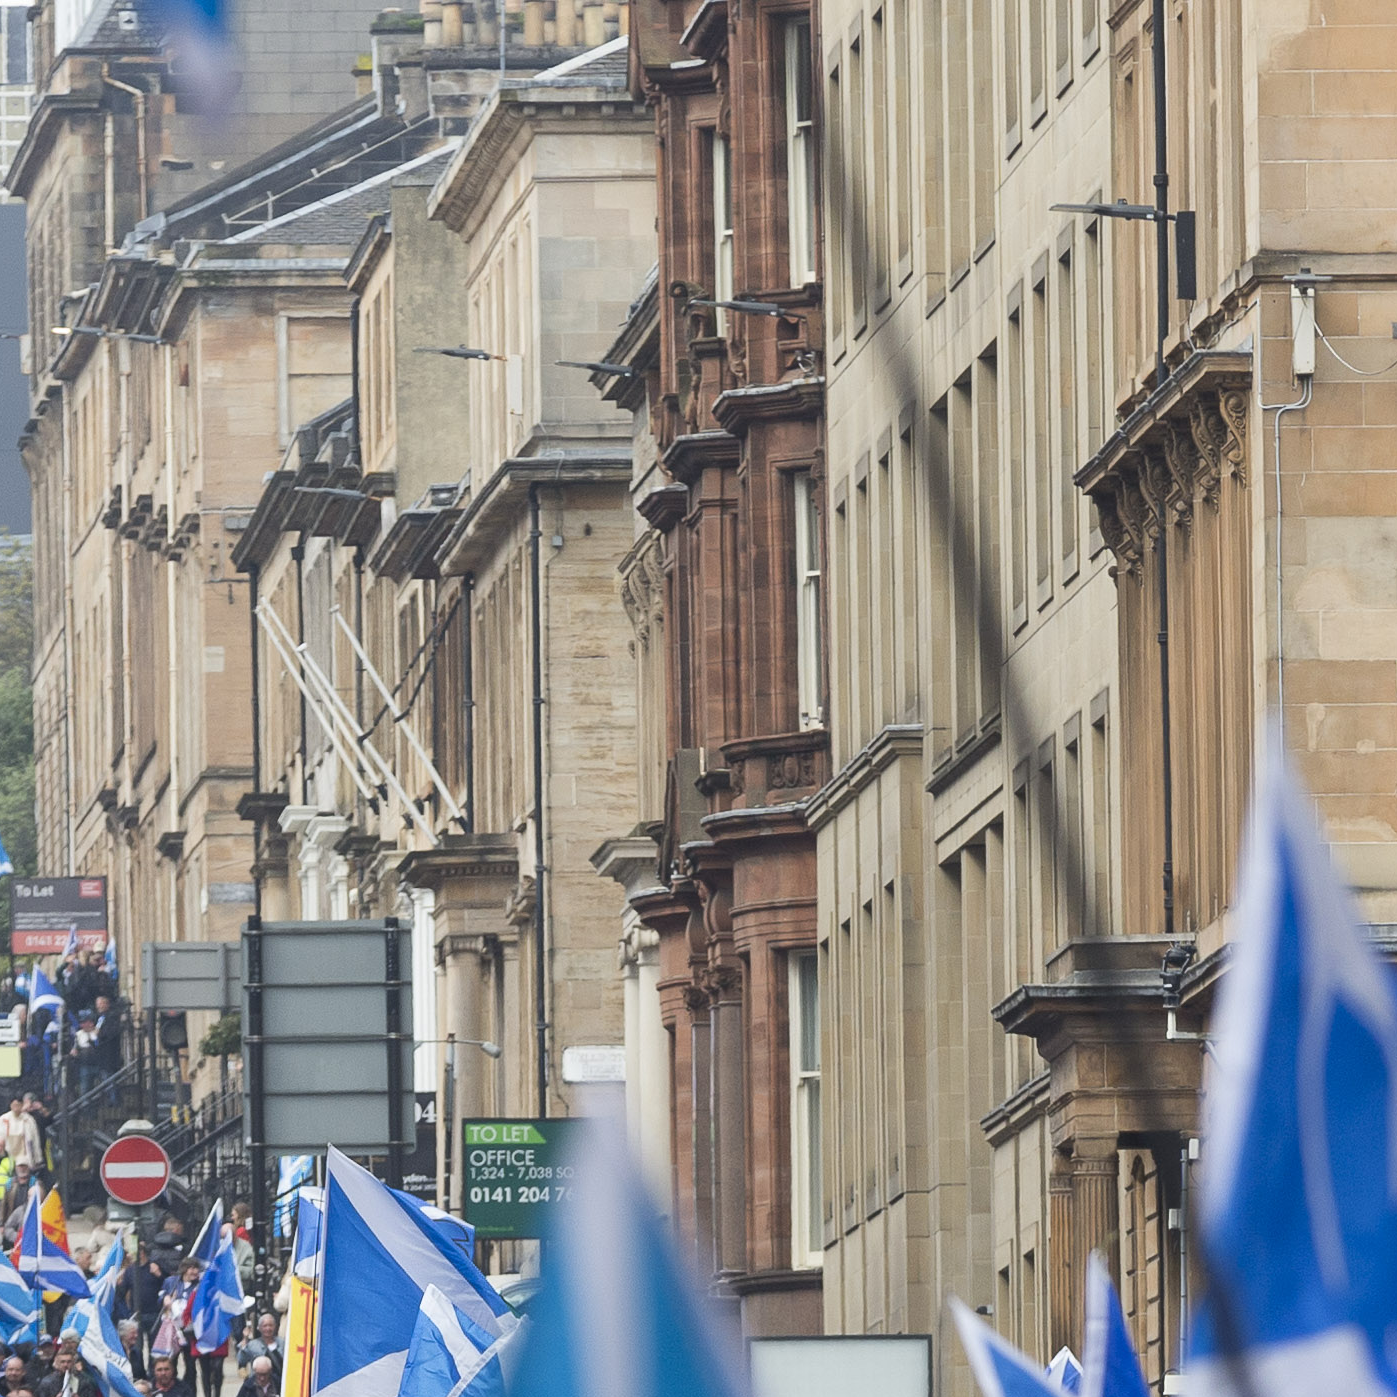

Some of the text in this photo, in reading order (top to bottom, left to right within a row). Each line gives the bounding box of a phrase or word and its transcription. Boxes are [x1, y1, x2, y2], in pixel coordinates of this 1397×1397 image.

[470, 1126, 531, 1142] TO LET
[469, 1149, 535, 1166] OFFICE
[470, 1167, 505, 1181] 1,324
[518, 1166, 553, 1181] 7,038
[470, 1187, 512, 1203] 0141
[518, 1187, 550, 1203] 204
